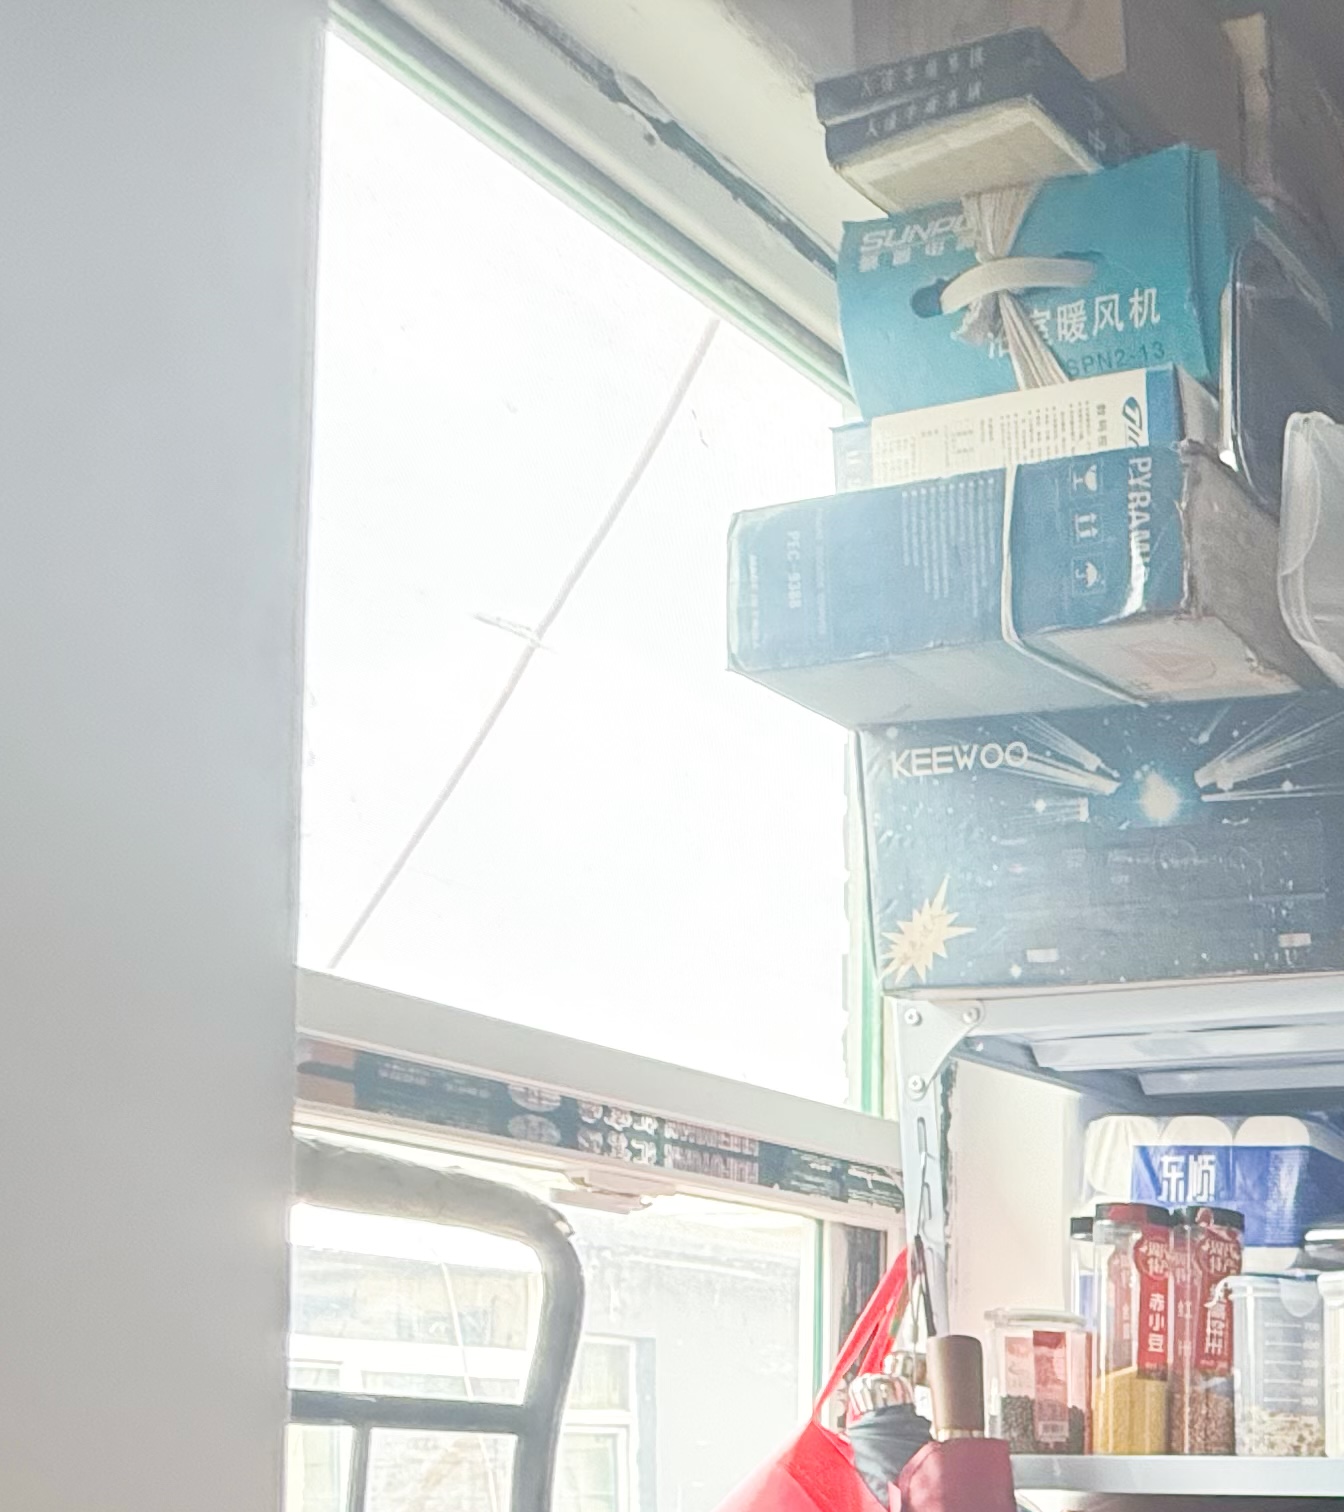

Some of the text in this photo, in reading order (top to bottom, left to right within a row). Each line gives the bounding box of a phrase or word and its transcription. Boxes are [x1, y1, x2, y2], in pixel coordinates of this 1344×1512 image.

[889, 741, 1029, 780] KEEWOO
[1160, 1153, 1217, 1204] 东顺
[1148, 1292, 1165, 1353] 赤小豆
